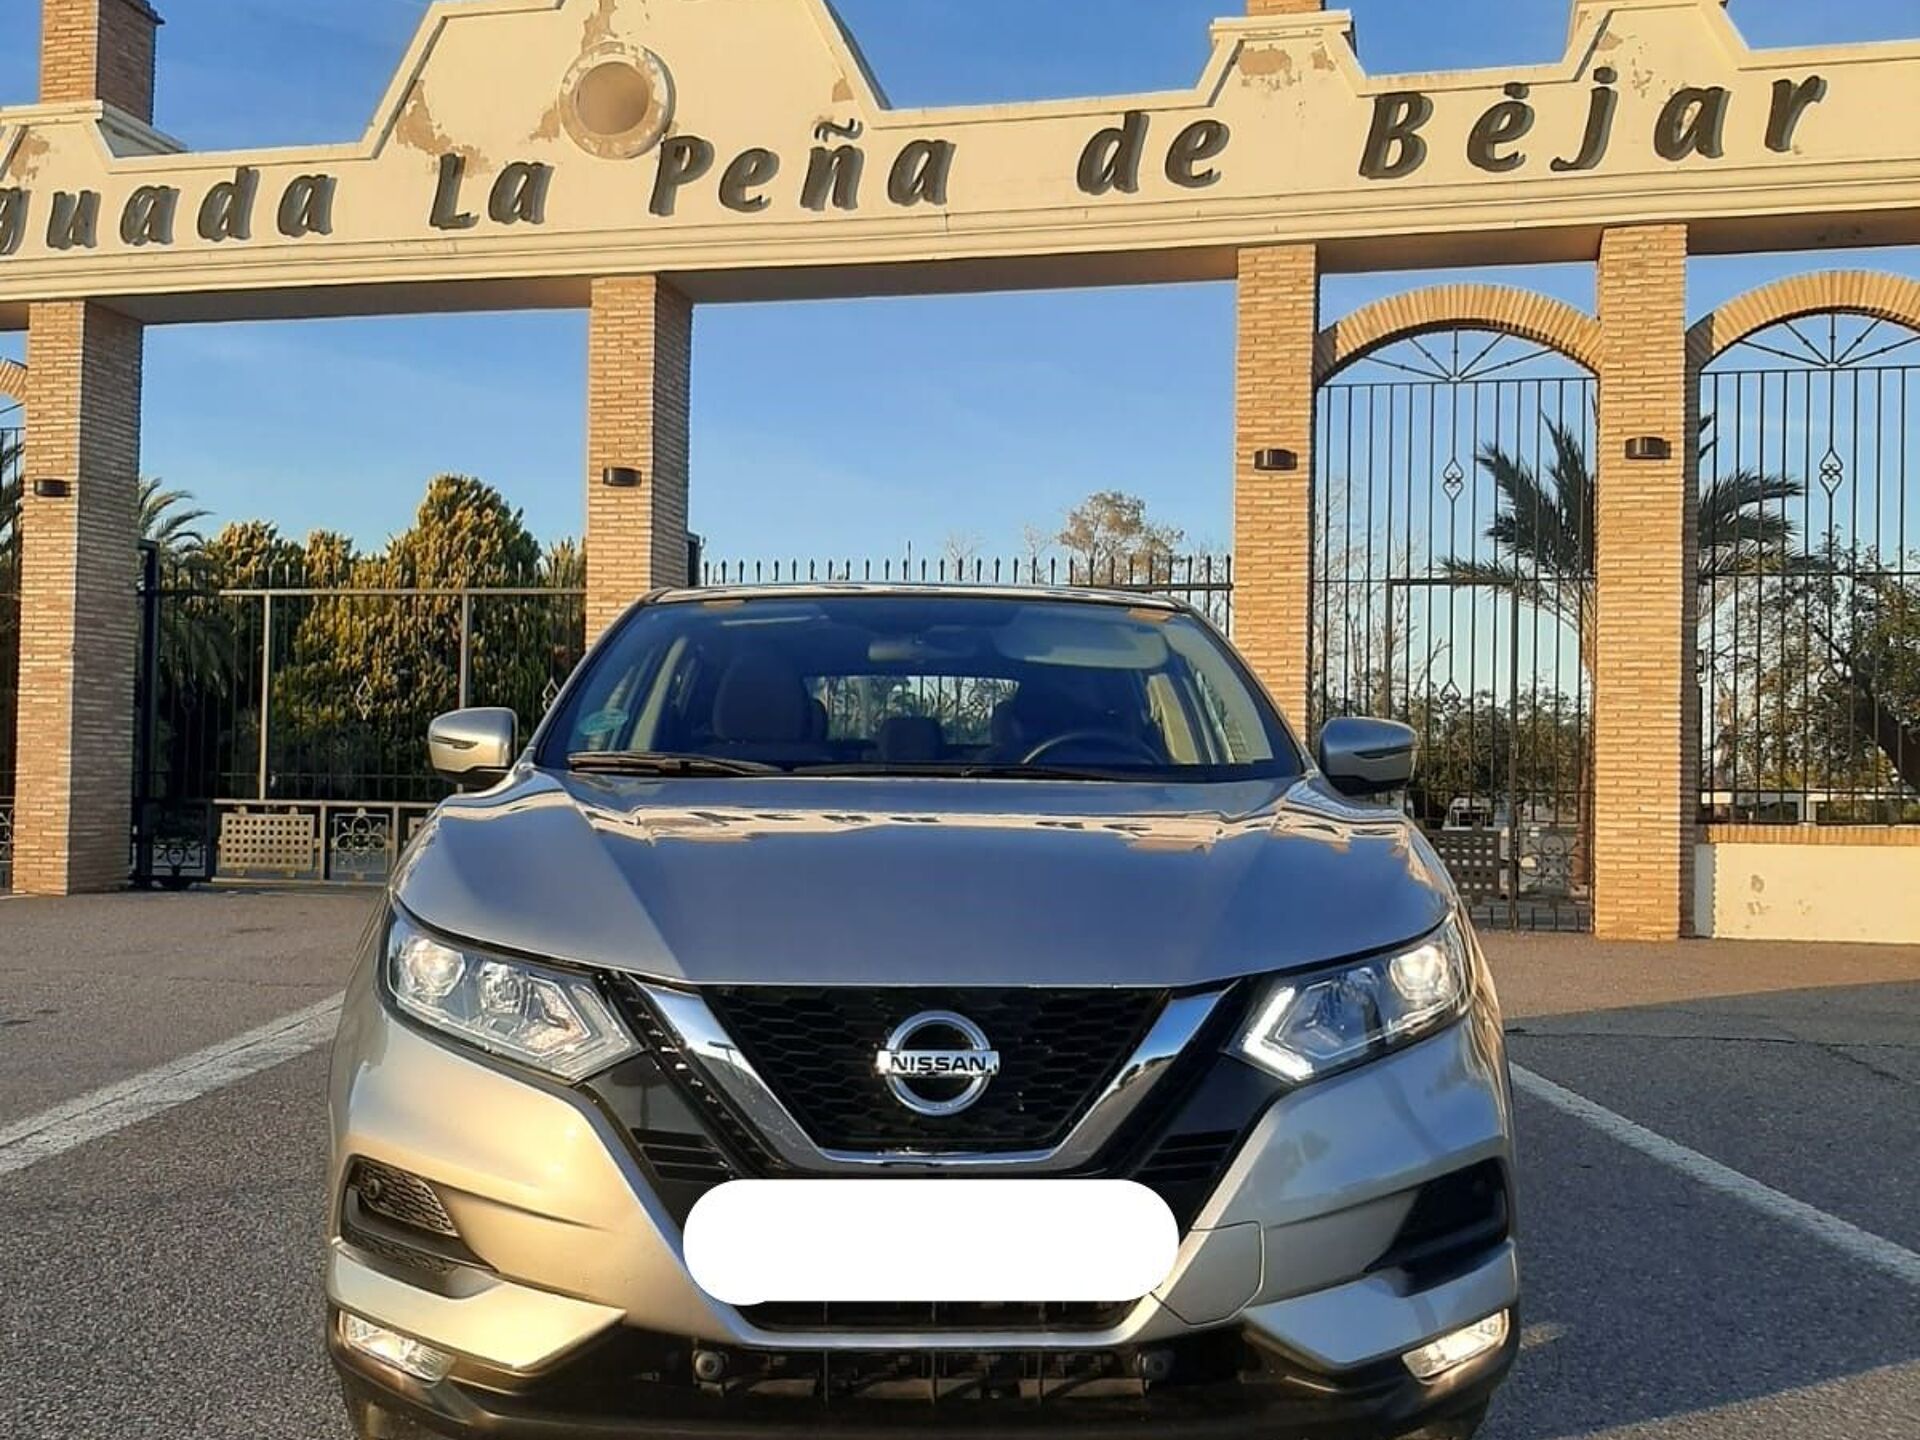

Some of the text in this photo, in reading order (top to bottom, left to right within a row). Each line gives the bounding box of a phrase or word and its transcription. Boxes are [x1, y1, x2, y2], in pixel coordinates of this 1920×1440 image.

[430, 153, 555, 230] La
[648, 117, 957, 217] Peña
[1076, 110, 1231, 196] de
[890, 1055, 987, 1072] NISSAN
